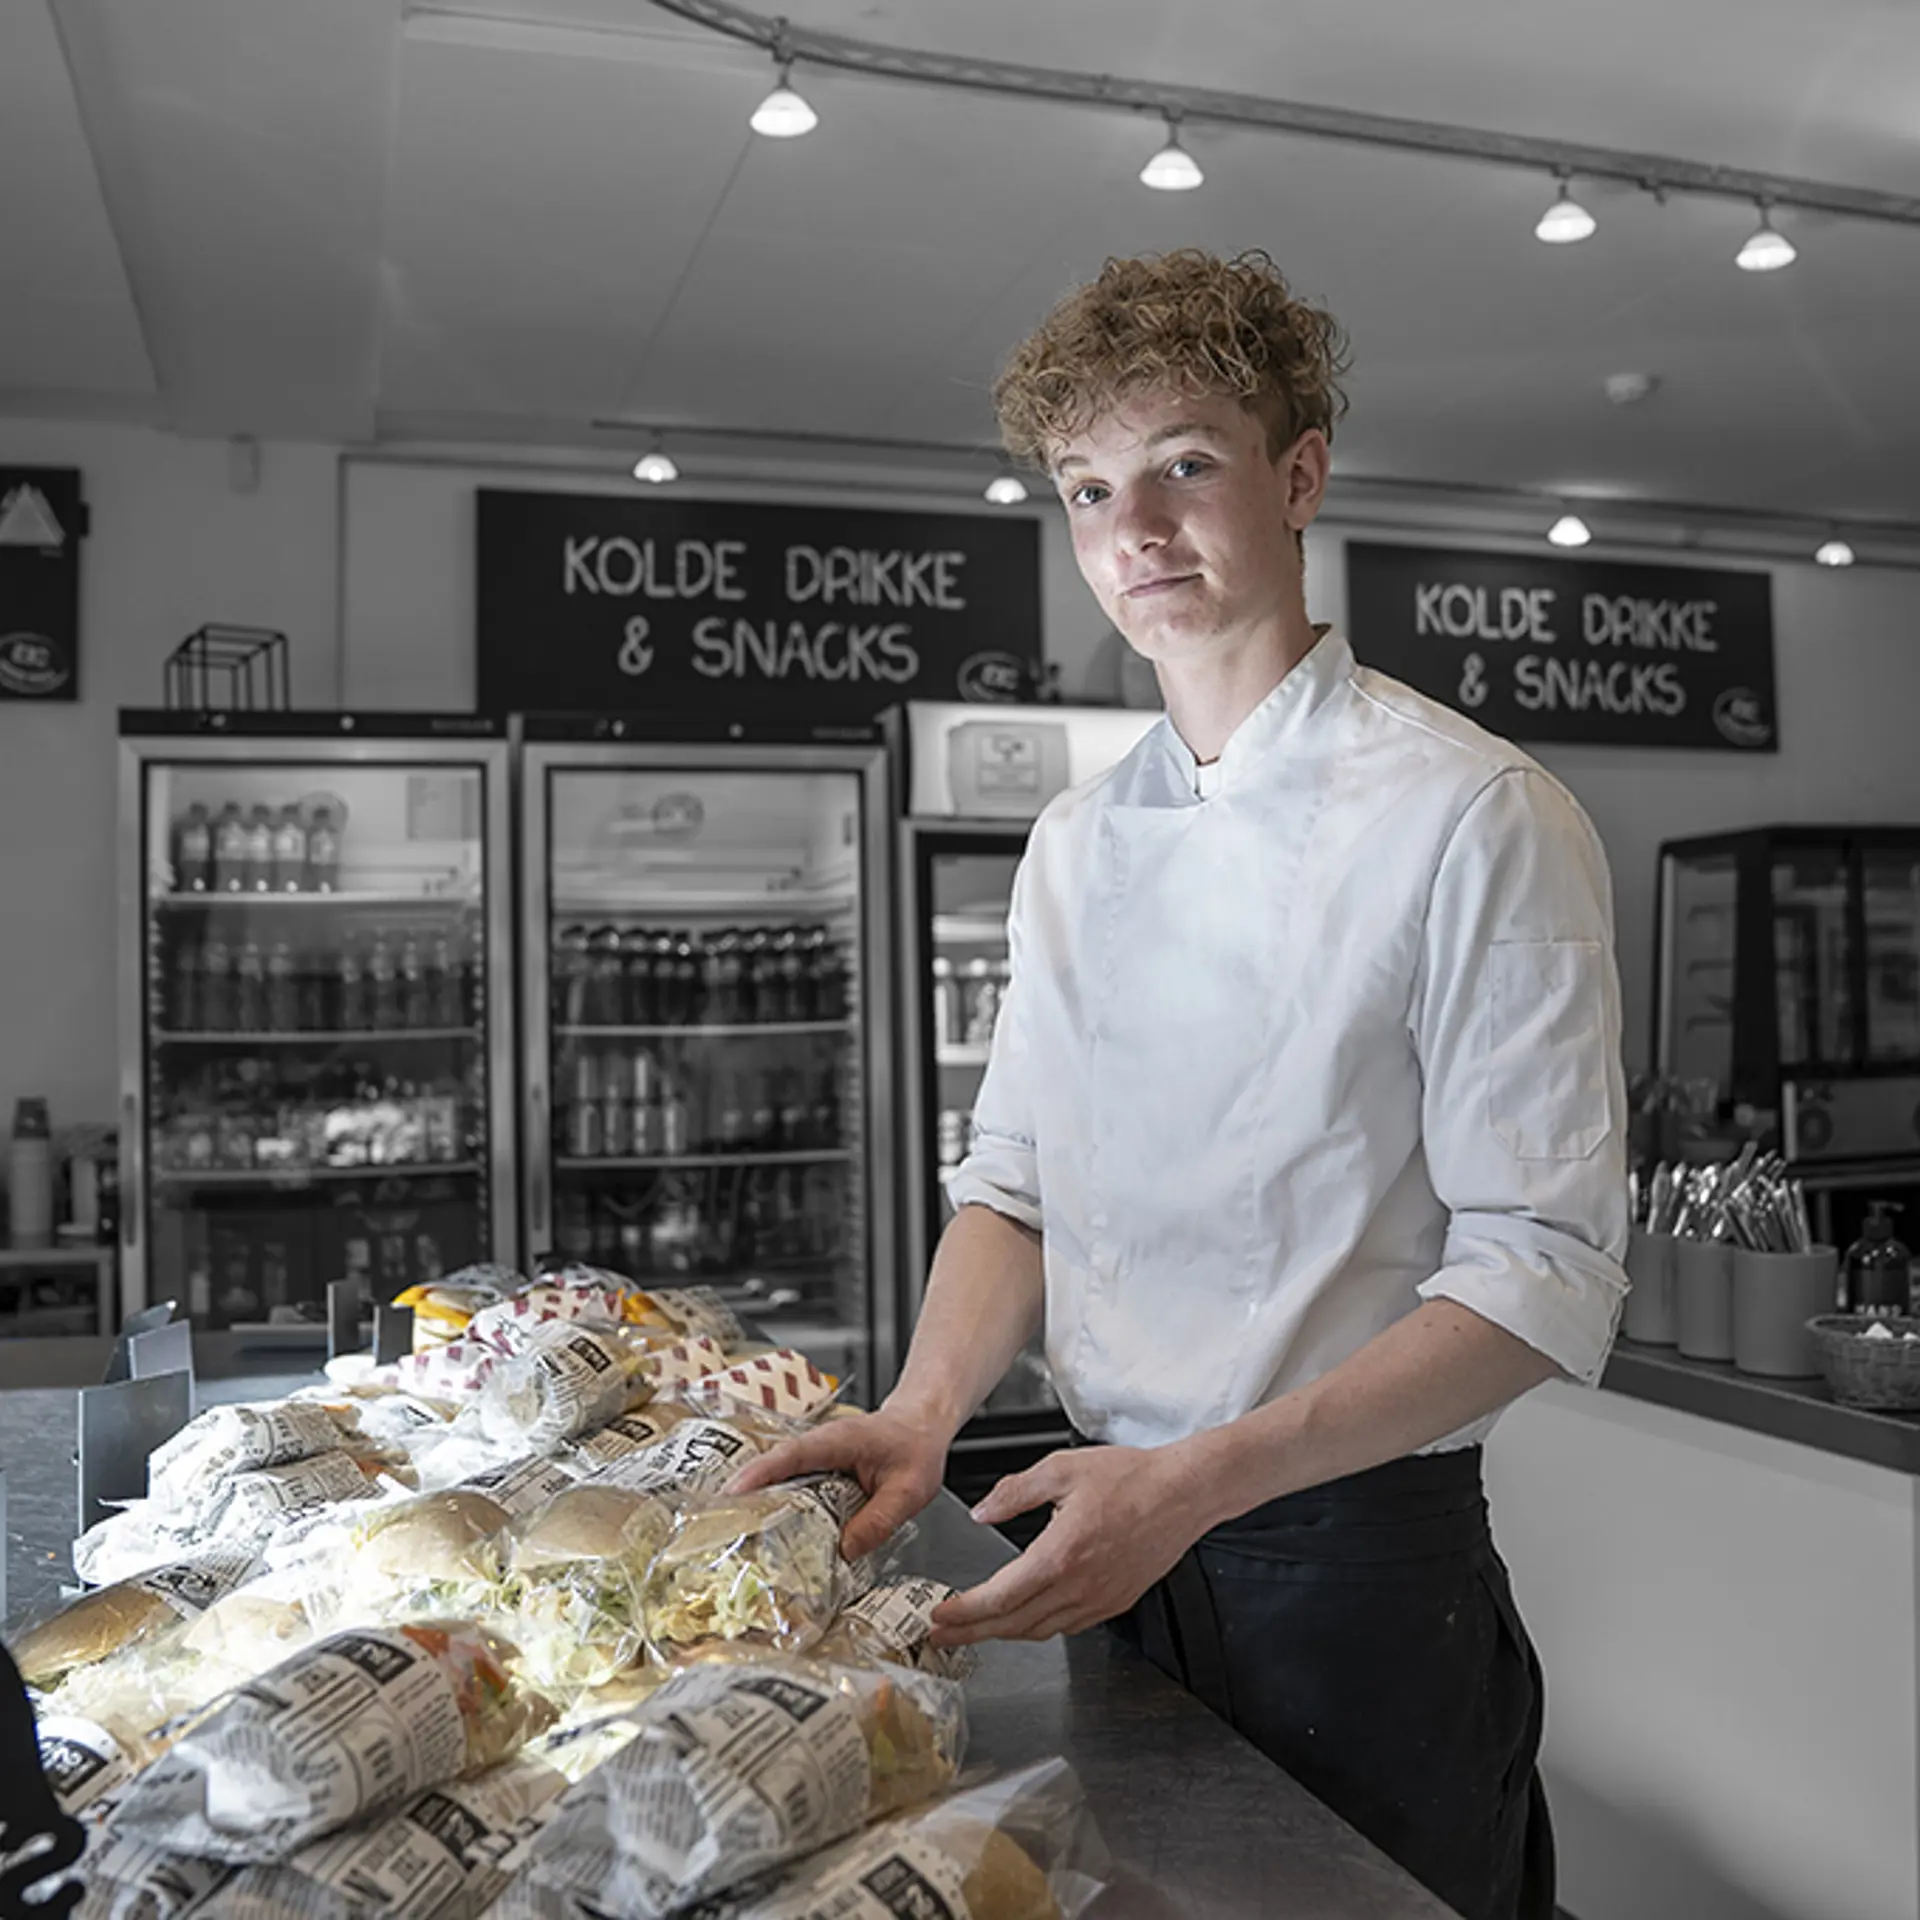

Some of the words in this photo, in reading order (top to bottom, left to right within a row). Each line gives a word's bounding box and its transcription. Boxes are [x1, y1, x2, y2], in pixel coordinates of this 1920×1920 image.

[564, 536, 746, 601] KOLDE
[786, 546, 967, 610] DRIKKE
[618, 615, 653, 675] &
[692, 617, 919, 683] SNACKS
[1415, 584, 1556, 643] KOLDE
[1582, 593, 1717, 652] DRIKKE
[1458, 652, 1488, 707] &
[1515, 655, 1684, 715] SNACKS
